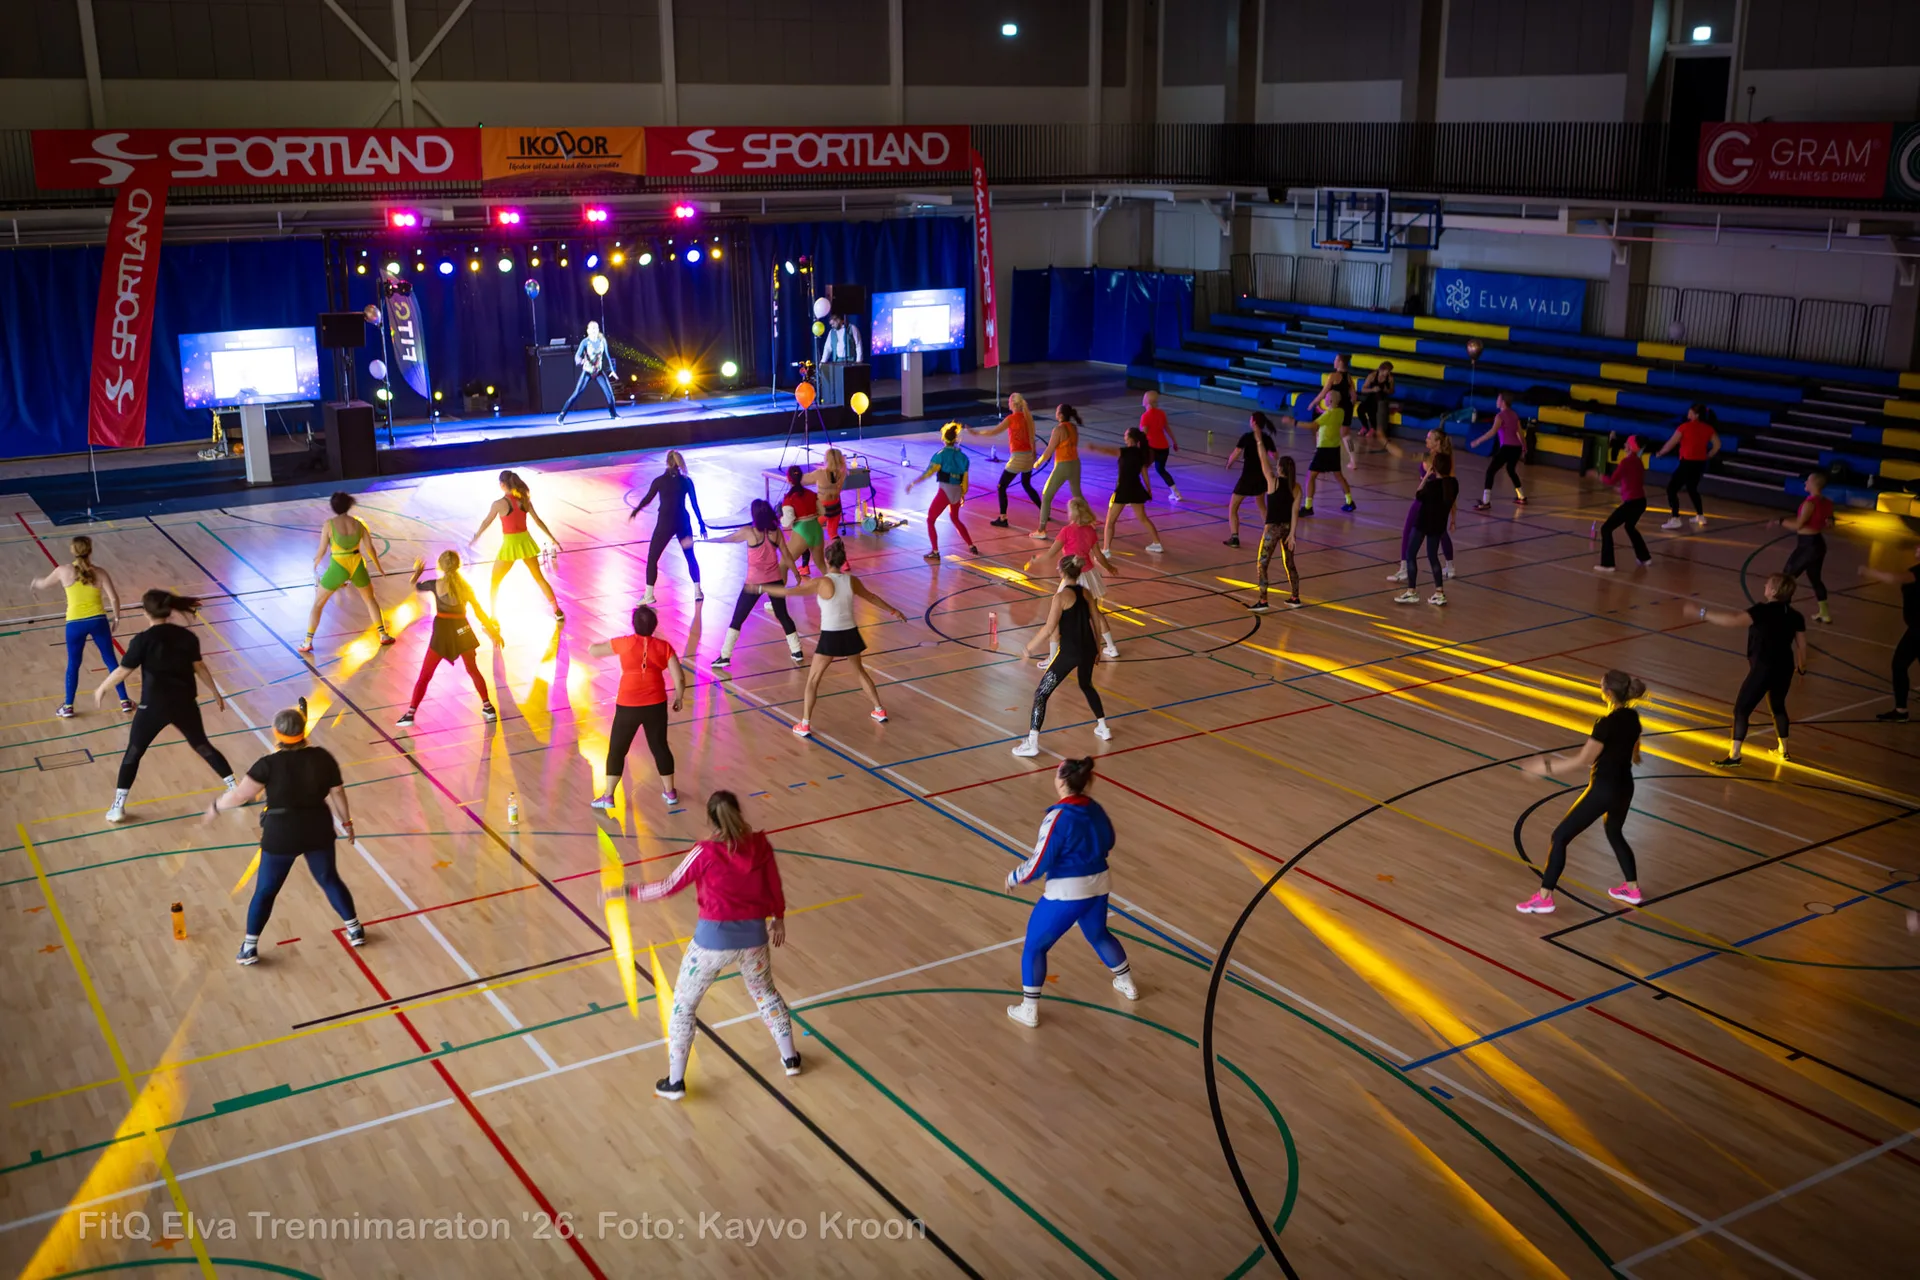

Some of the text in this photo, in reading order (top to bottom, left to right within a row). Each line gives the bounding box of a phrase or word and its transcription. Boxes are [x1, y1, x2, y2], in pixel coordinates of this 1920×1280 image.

[168, 135, 454, 178] SPORTLAND
[520, 130, 609, 159] IKODOR
[742, 131, 950, 168] SPORTLAND
[1768, 170, 1866, 183] WELLNESS DRINK
[111, 188, 153, 361] SPORTLAND
[1479, 290, 1571, 316] ELVA VALD
